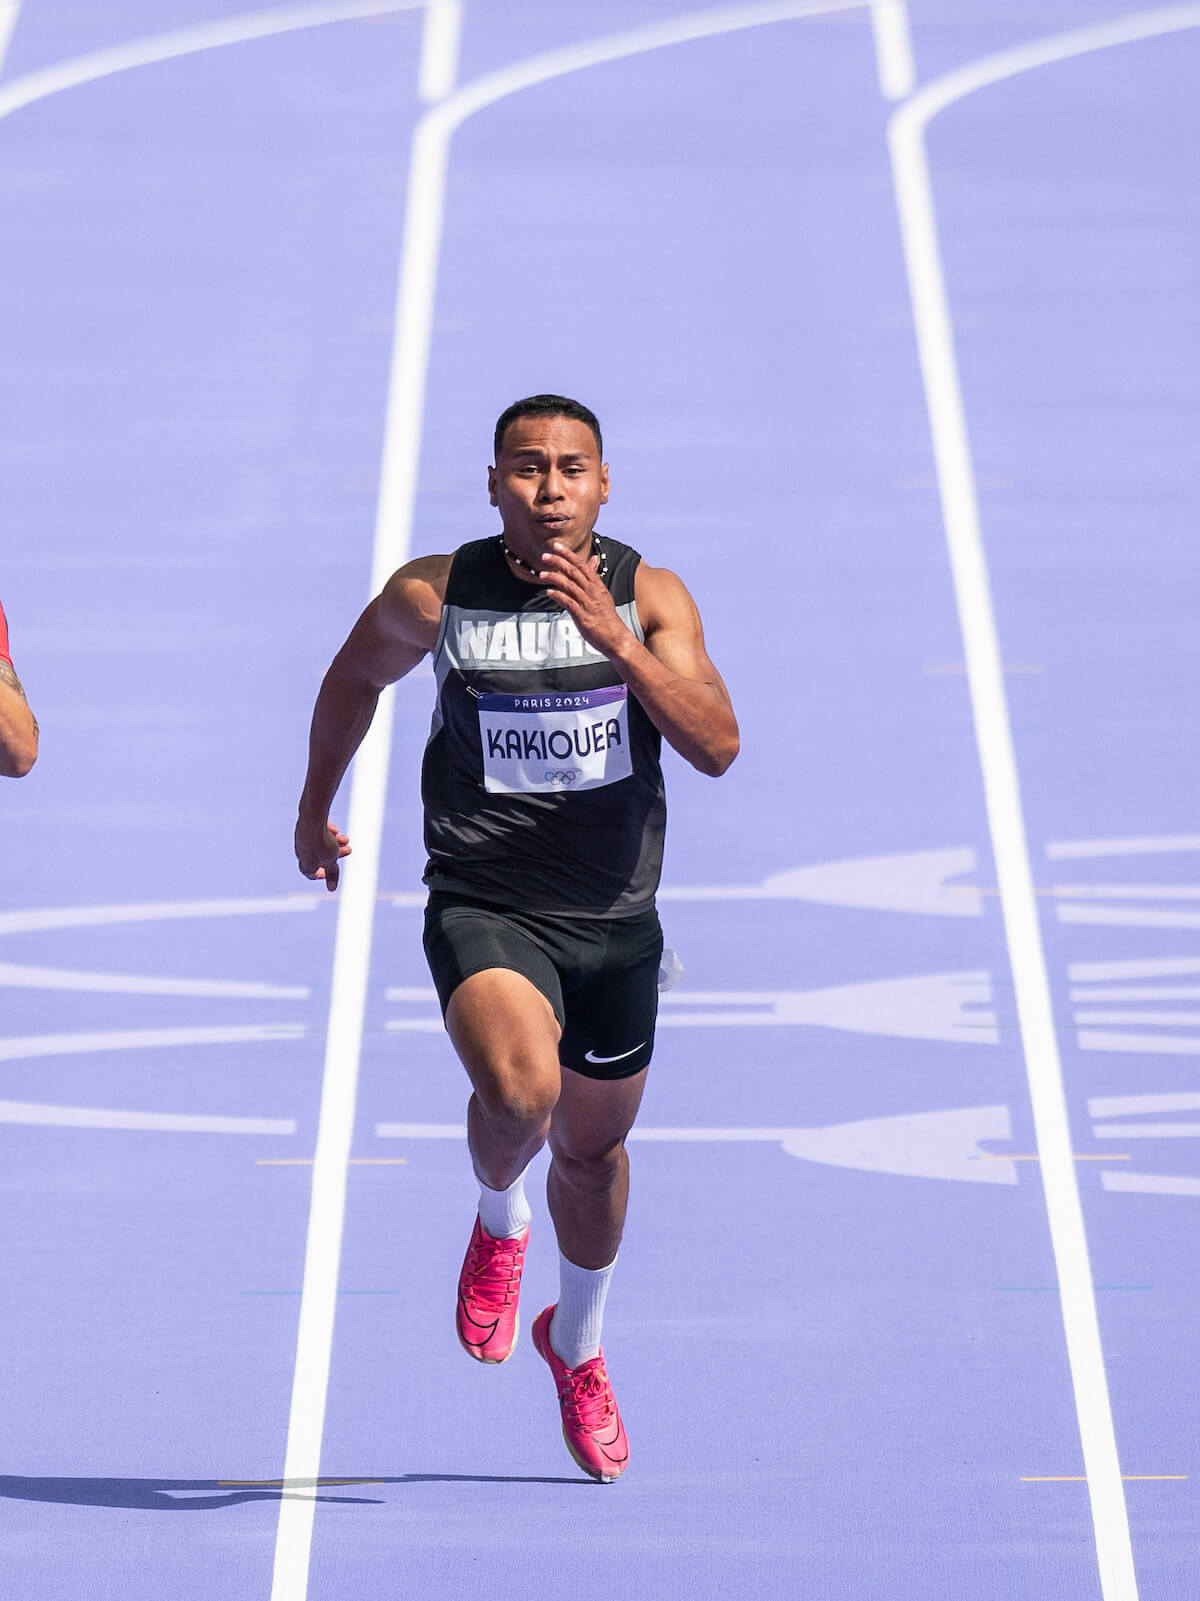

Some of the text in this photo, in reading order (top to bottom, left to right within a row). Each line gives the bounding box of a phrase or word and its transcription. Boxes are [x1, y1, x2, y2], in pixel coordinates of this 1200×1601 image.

[460, 620, 603, 661] NAUR
[515, 696, 590, 708] PARIS 2024
[487, 718, 622, 760] KAKIOUEA
